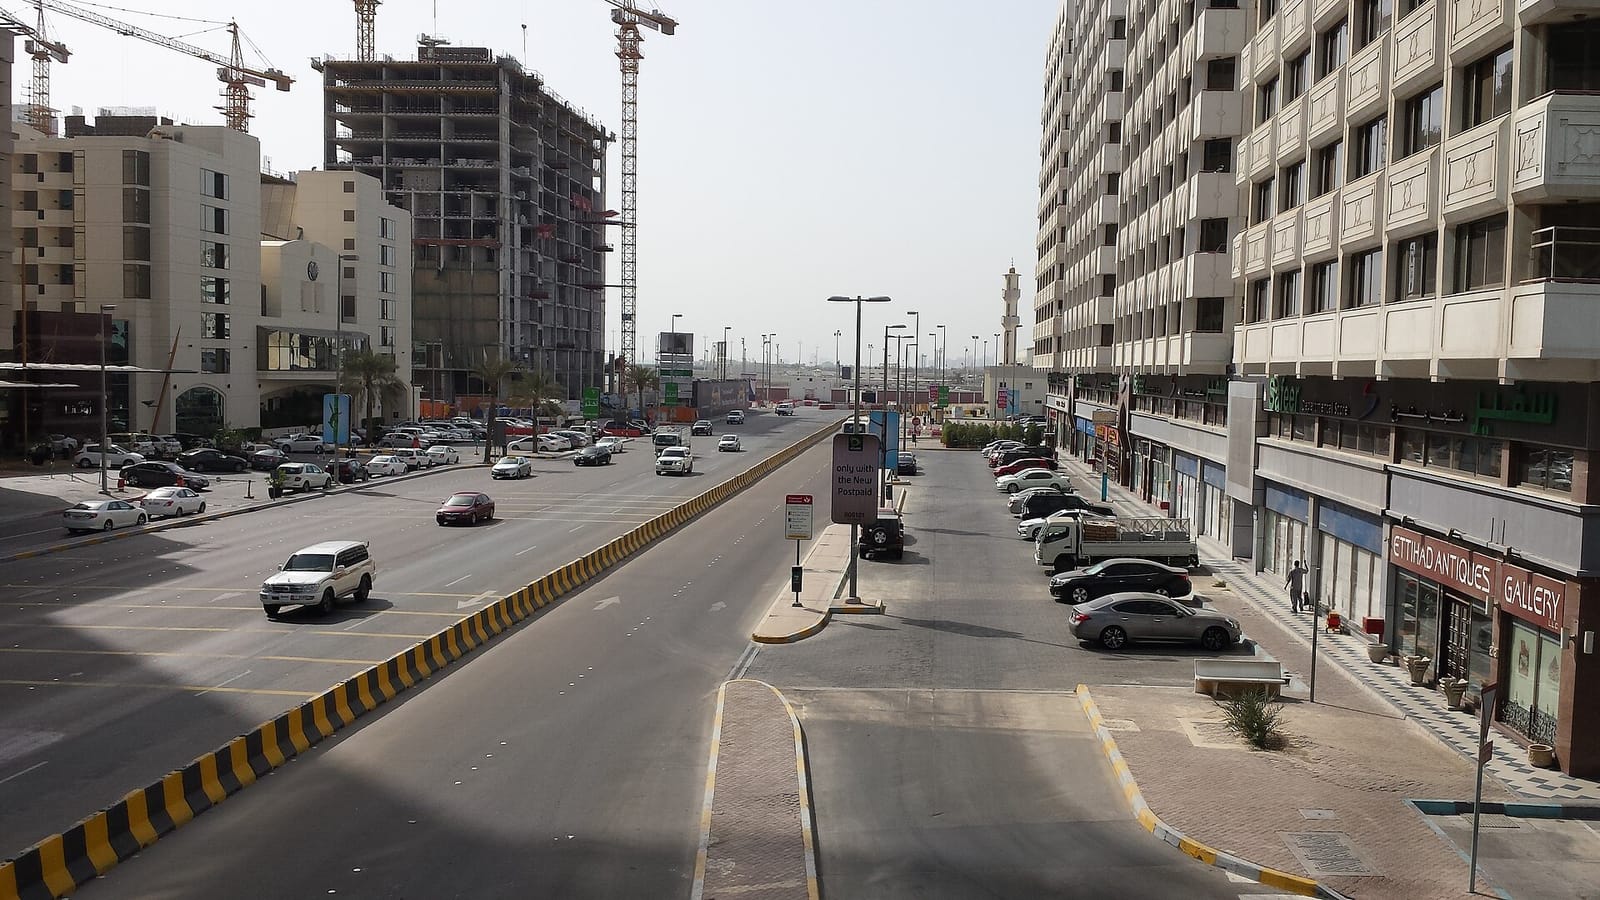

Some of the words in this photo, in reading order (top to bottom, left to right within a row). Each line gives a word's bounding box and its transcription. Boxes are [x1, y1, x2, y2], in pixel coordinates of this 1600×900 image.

[1268, 376, 1302, 412] Safeer
[836, 464, 853, 474] only
[856, 464, 874, 473] with
[838, 476, 851, 484] the
[853, 476, 872, 484] New
[837, 487, 872, 497] Postpaid
[1393, 535, 1433, 570] ETTIHAD
[1434, 551, 1491, 594] ANTIQUES
[1504, 575, 1561, 621] GALLERY
